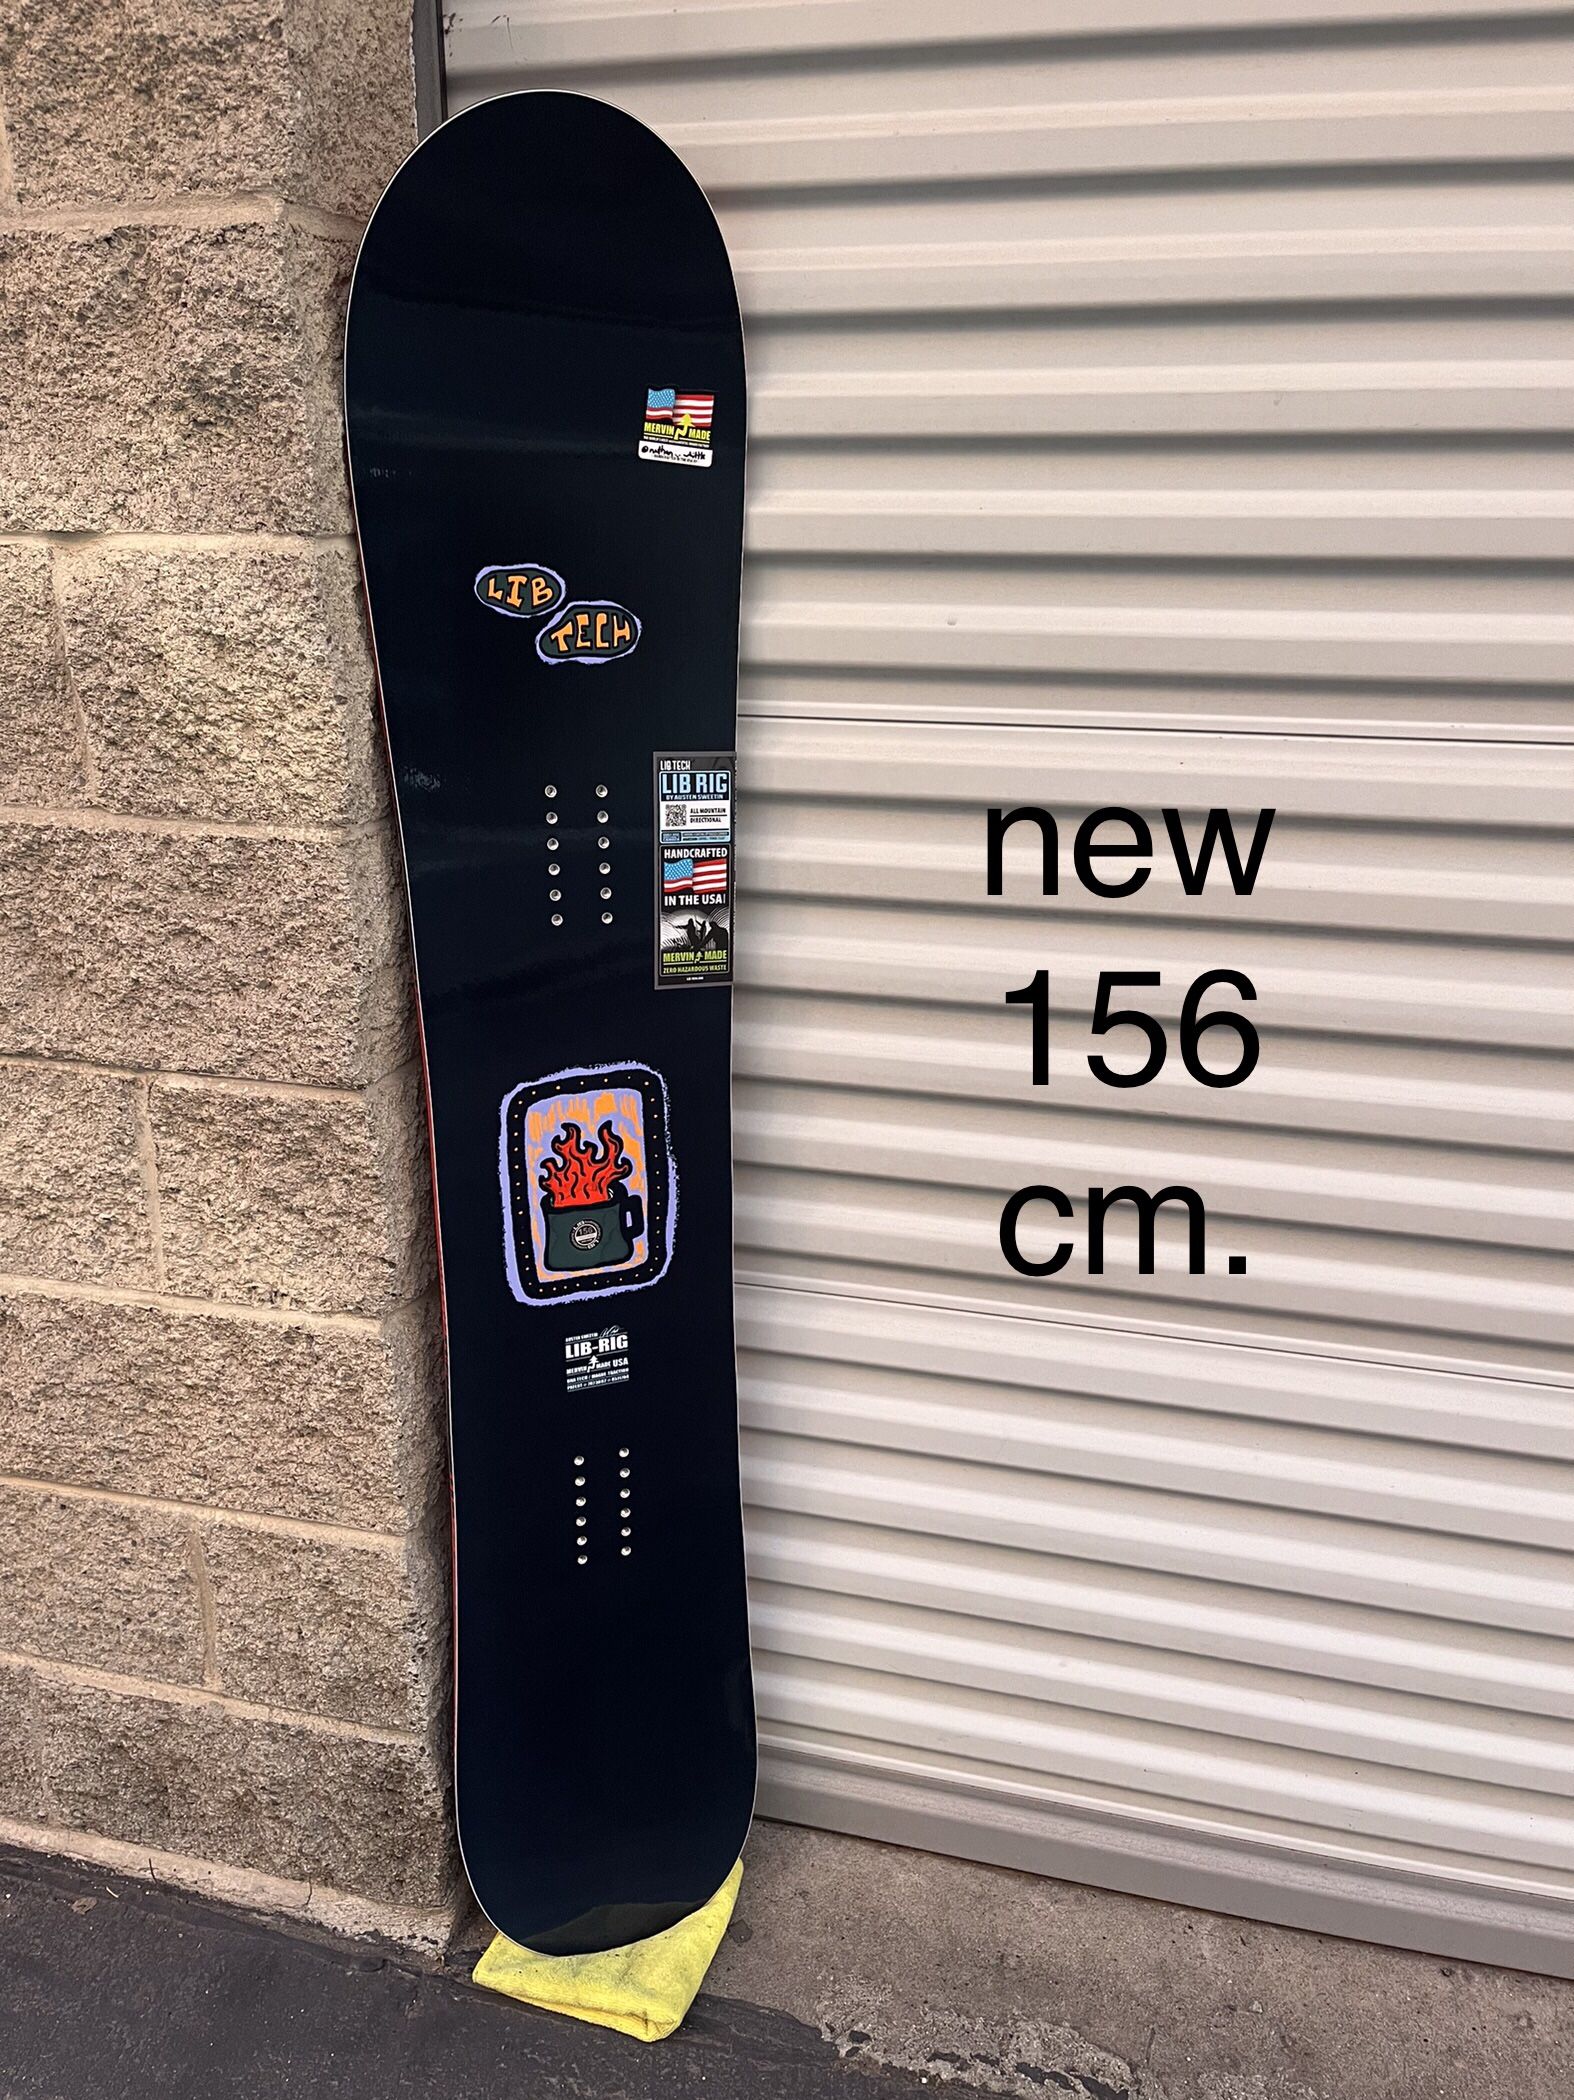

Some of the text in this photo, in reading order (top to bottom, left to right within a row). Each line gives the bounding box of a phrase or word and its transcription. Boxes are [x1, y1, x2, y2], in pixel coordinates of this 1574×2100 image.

[644, 422, 711, 440] MERVIN MADE
[488, 575, 553, 608] LIB
[550, 612, 631, 652] TECH
[660, 760, 691, 771] LIB TECH
[662, 773, 728, 794] LIB RIG
[663, 847, 729, 859] HANDCRAFTED
[664, 895, 677, 906] IN
[678, 894, 700, 906] THE
[663, 949, 728, 963] MERVIN MADE
[565, 1334, 628, 1358] LIB-RIG
[612, 1357, 629, 1368] USA
